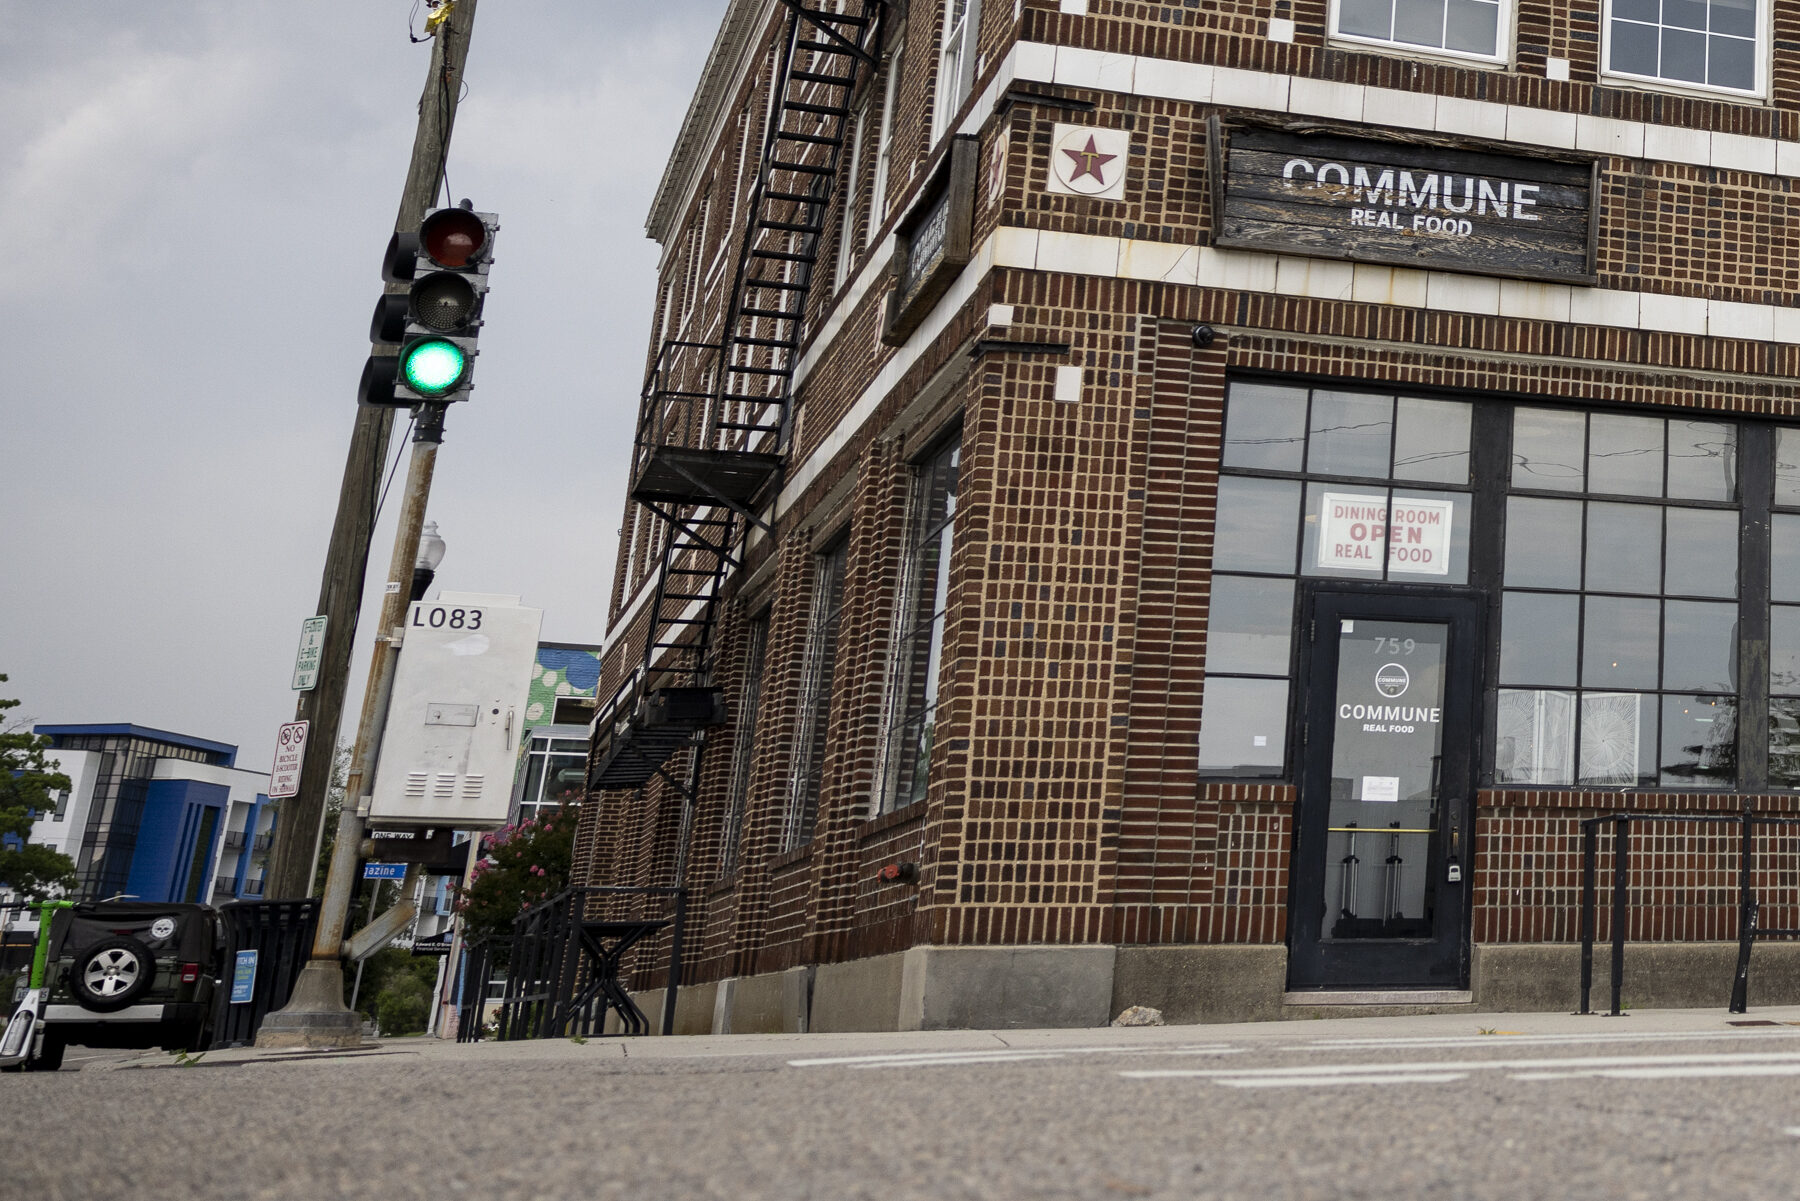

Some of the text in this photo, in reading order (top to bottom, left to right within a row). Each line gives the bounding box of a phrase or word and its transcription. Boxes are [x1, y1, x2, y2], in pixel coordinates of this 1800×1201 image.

[1283, 158, 1540, 222] COMMUNE
[1351, 207, 1473, 237] REAL FOOD
[1334, 505, 1440, 525] DINING ROOM
[1350, 522, 1422, 544] OPEN
[1335, 543, 1433, 563] REAL FOOD
[1374, 636, 1415, 655] 759
[1339, 704, 1441, 722] COMMUNE
[1363, 724, 1415, 733] REAL FOOD
